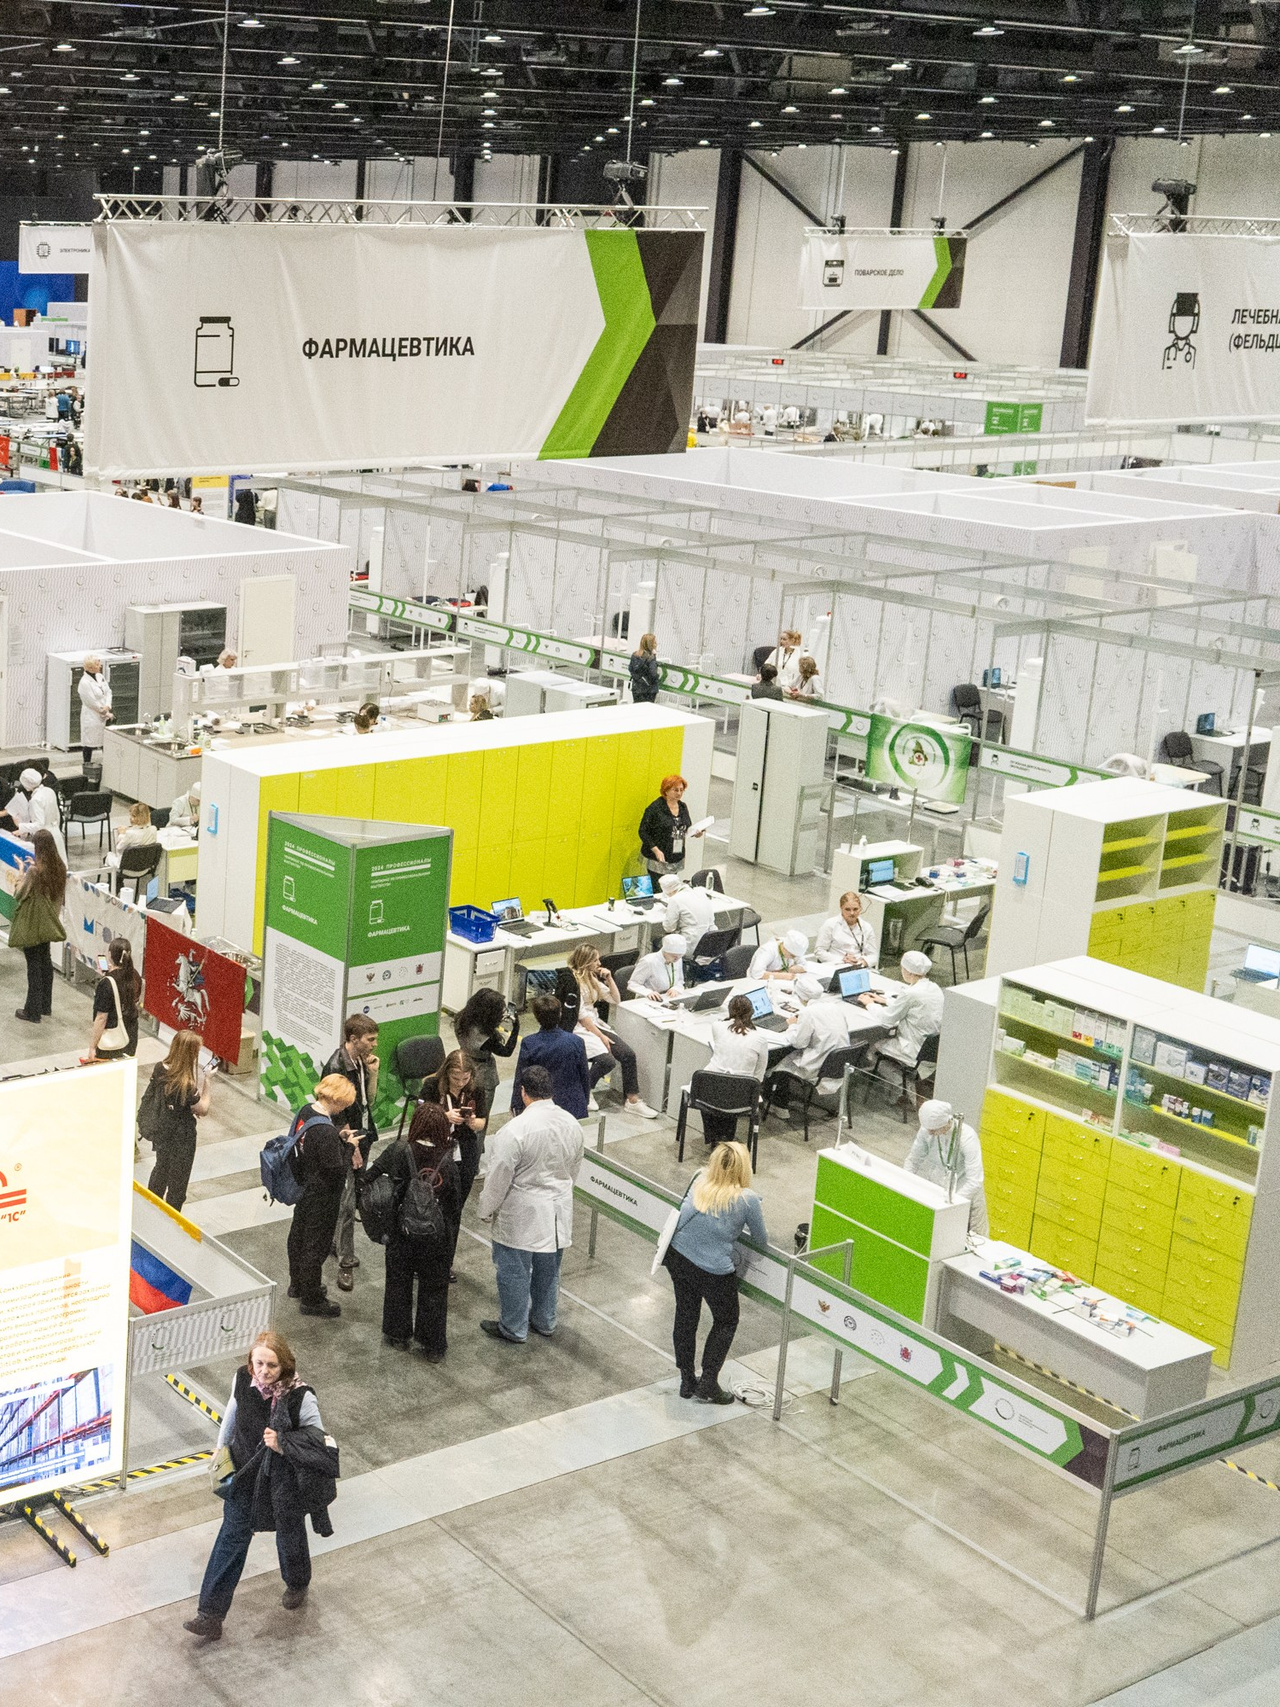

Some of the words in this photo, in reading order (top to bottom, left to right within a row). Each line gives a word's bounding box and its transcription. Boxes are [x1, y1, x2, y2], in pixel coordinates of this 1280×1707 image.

[1231, 308, 1280, 325] ЛЕЧЕБН
[302, 336, 475, 362] ФАРМАЦЕВТИКА
[590, 1176, 638, 1206] ФАРМАЦЕВТИКА
